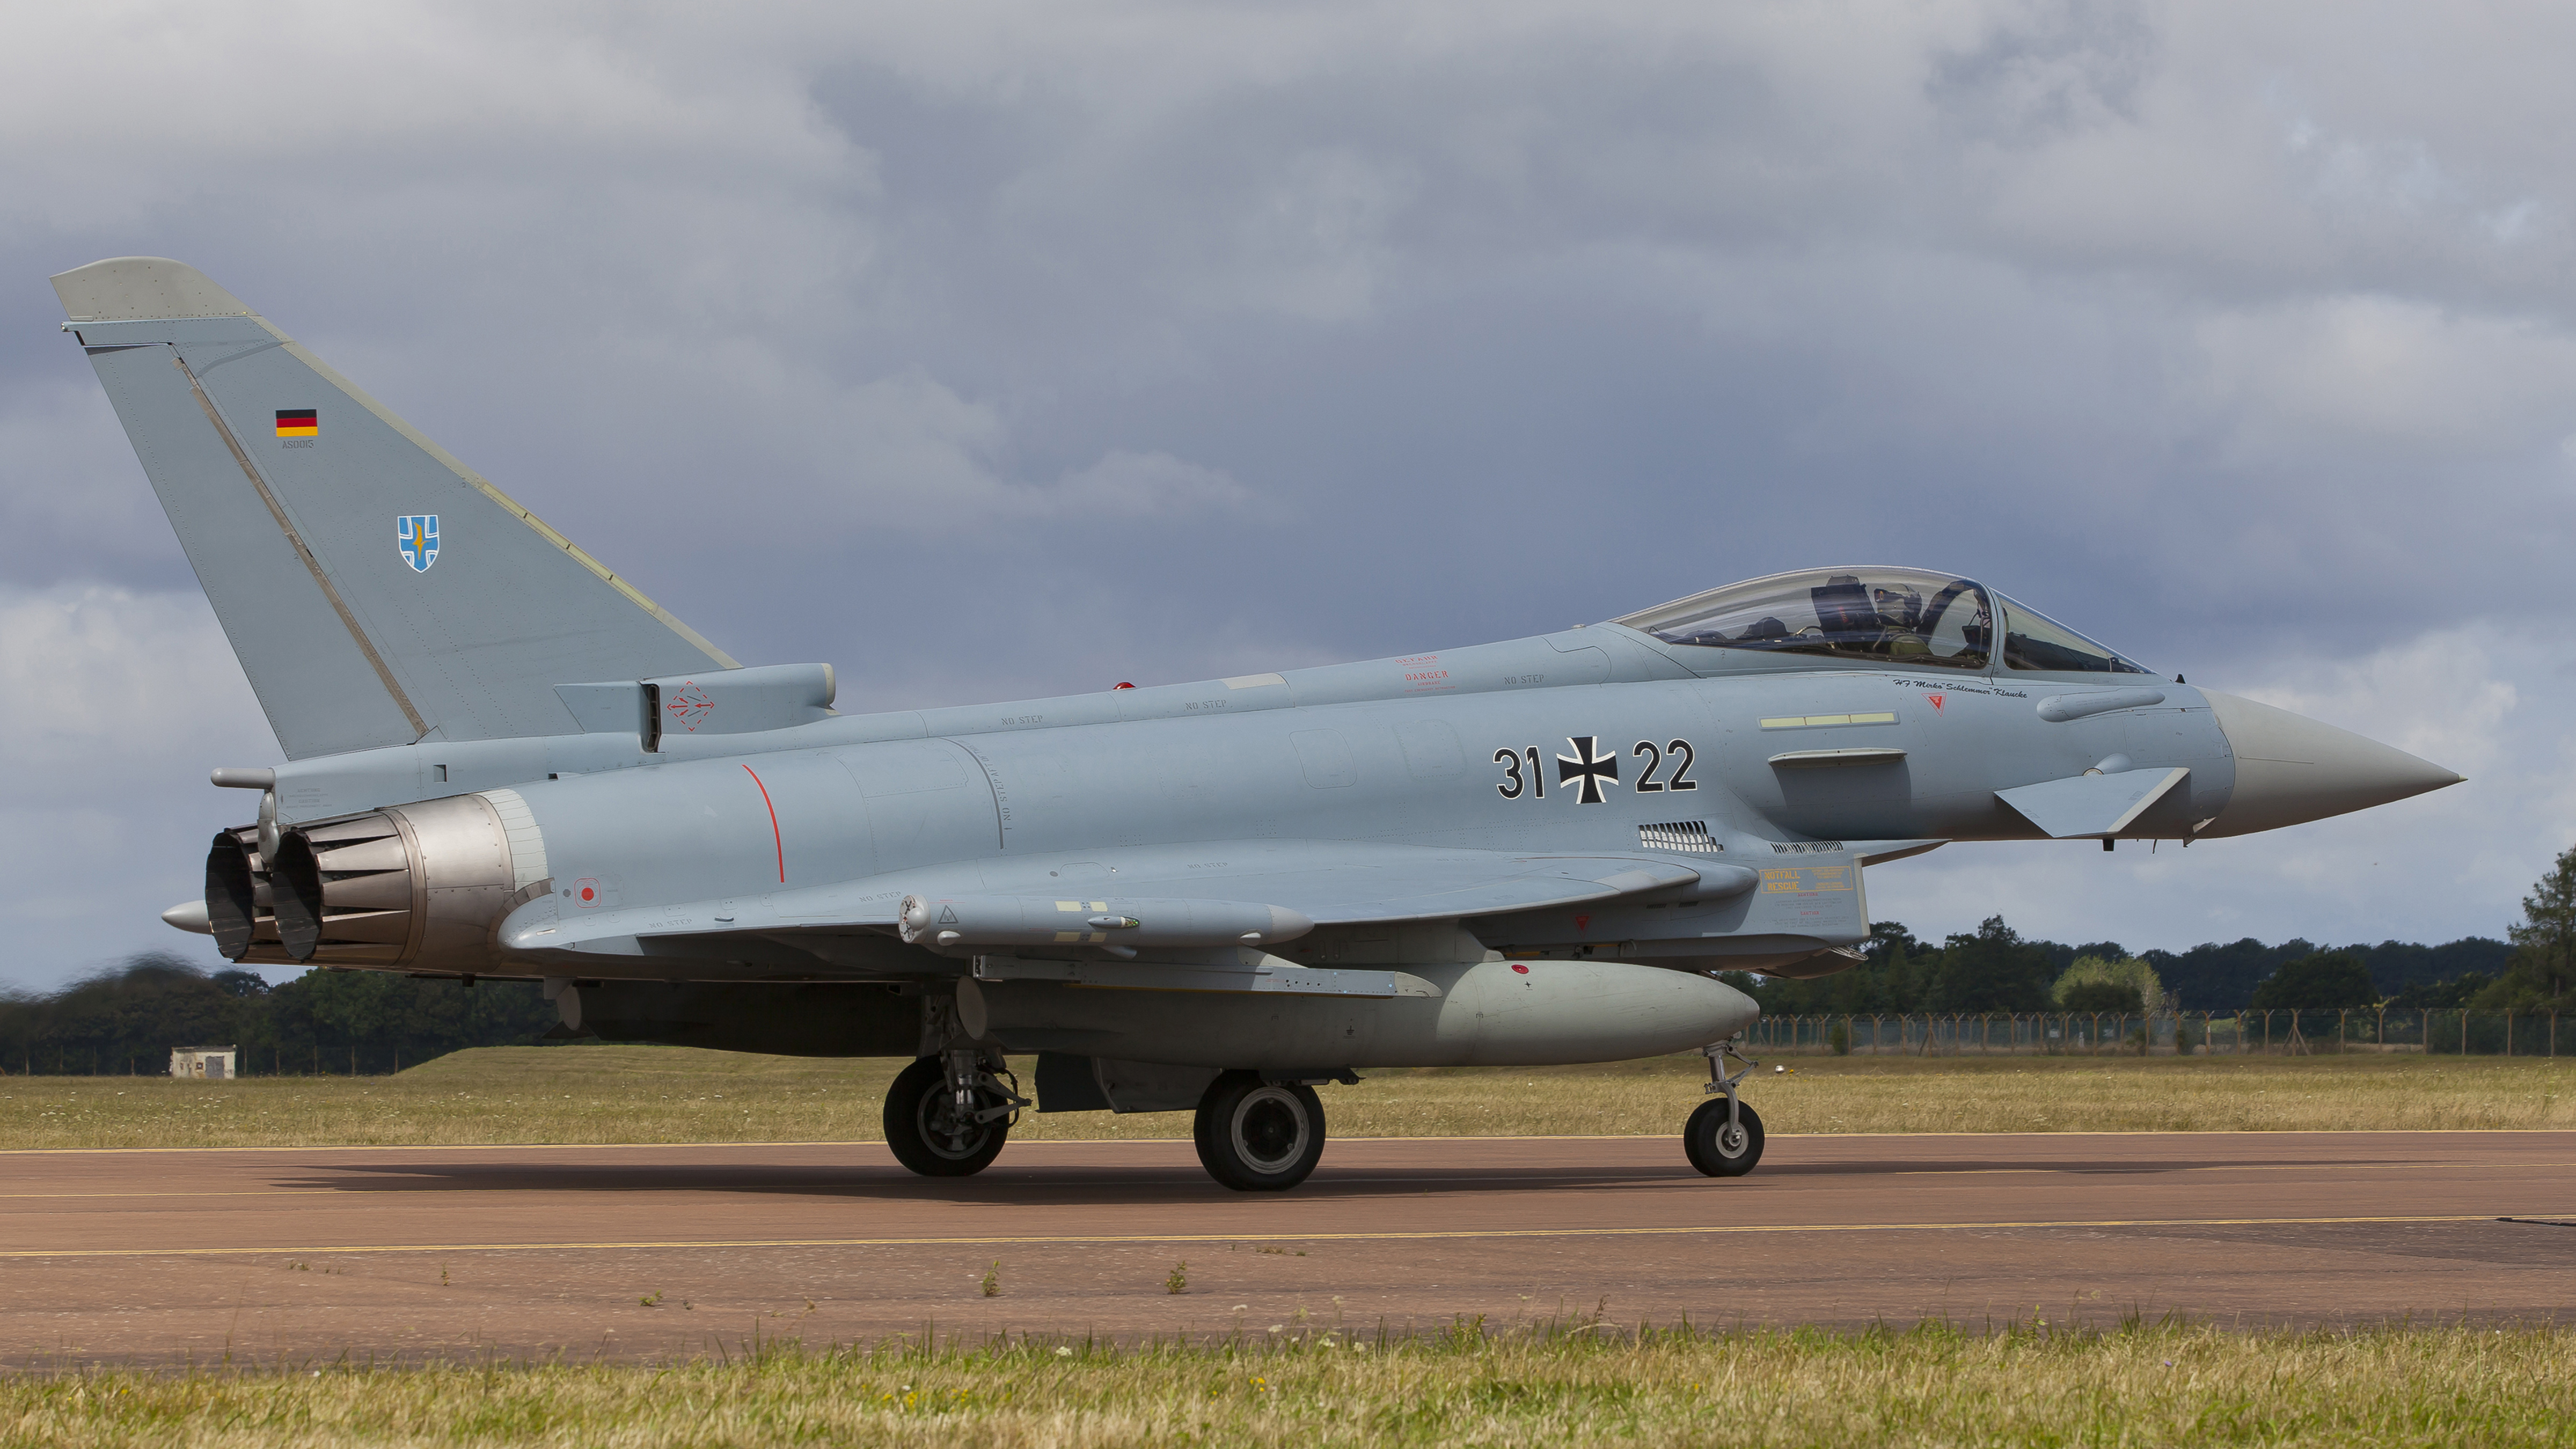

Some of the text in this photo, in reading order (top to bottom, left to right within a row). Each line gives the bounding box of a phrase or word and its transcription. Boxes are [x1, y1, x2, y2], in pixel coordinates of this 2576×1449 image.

[1404, 670, 1448, 680] DANGER
[1504, 674, 1544, 685] NO STEP
[1185, 700, 1226, 710] NO STEP
[1019, 715, 1043, 724] STEP
[1633, 738, 1697, 793] 22
[1493, 745, 1545, 800] 31
[993, 779, 1007, 802] STEP
[1002, 808, 1011, 821] NO
[1764, 870, 1801, 880] NOTFALL
[1767, 881, 1799, 891] RESCUE
[876, 891, 901, 899] STEP
